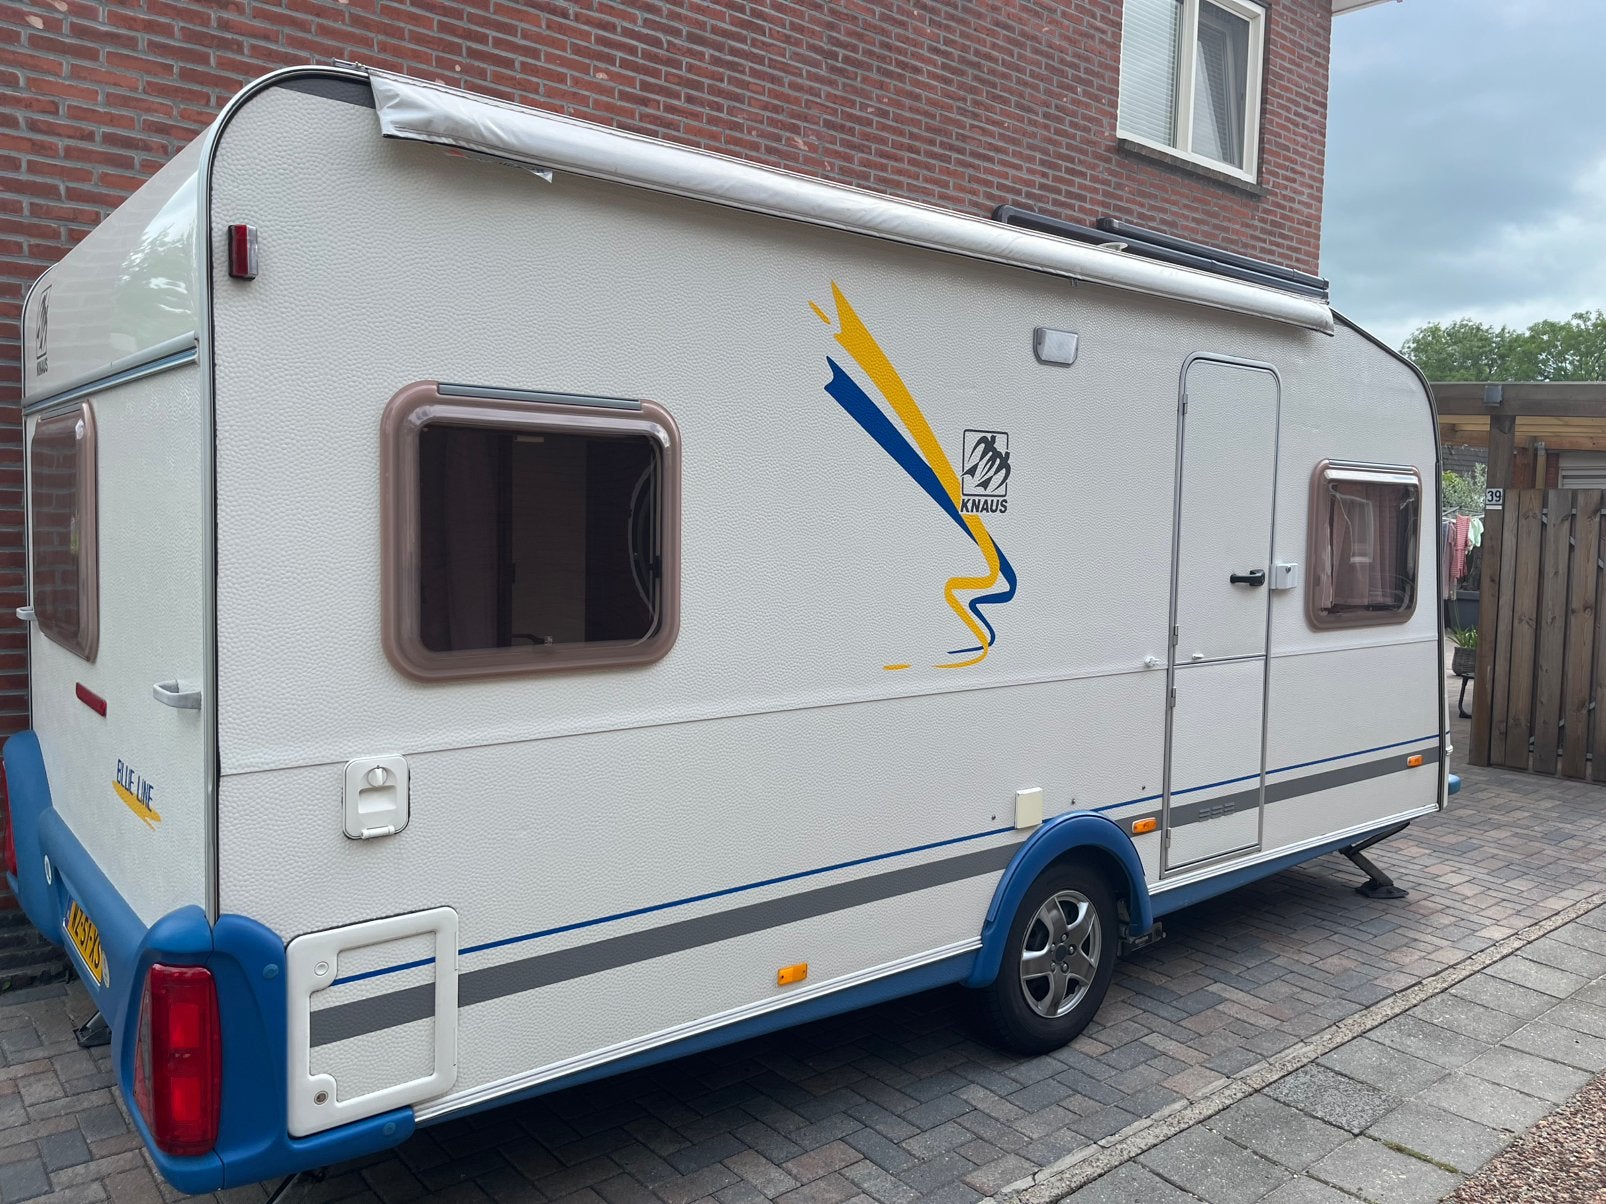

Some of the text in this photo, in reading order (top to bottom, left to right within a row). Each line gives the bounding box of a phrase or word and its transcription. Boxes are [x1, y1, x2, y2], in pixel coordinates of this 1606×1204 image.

[1487, 490, 1502, 502] 39
[960, 498, 1008, 513] KNAUS
[116, 758, 154, 812] BLUE LINE
